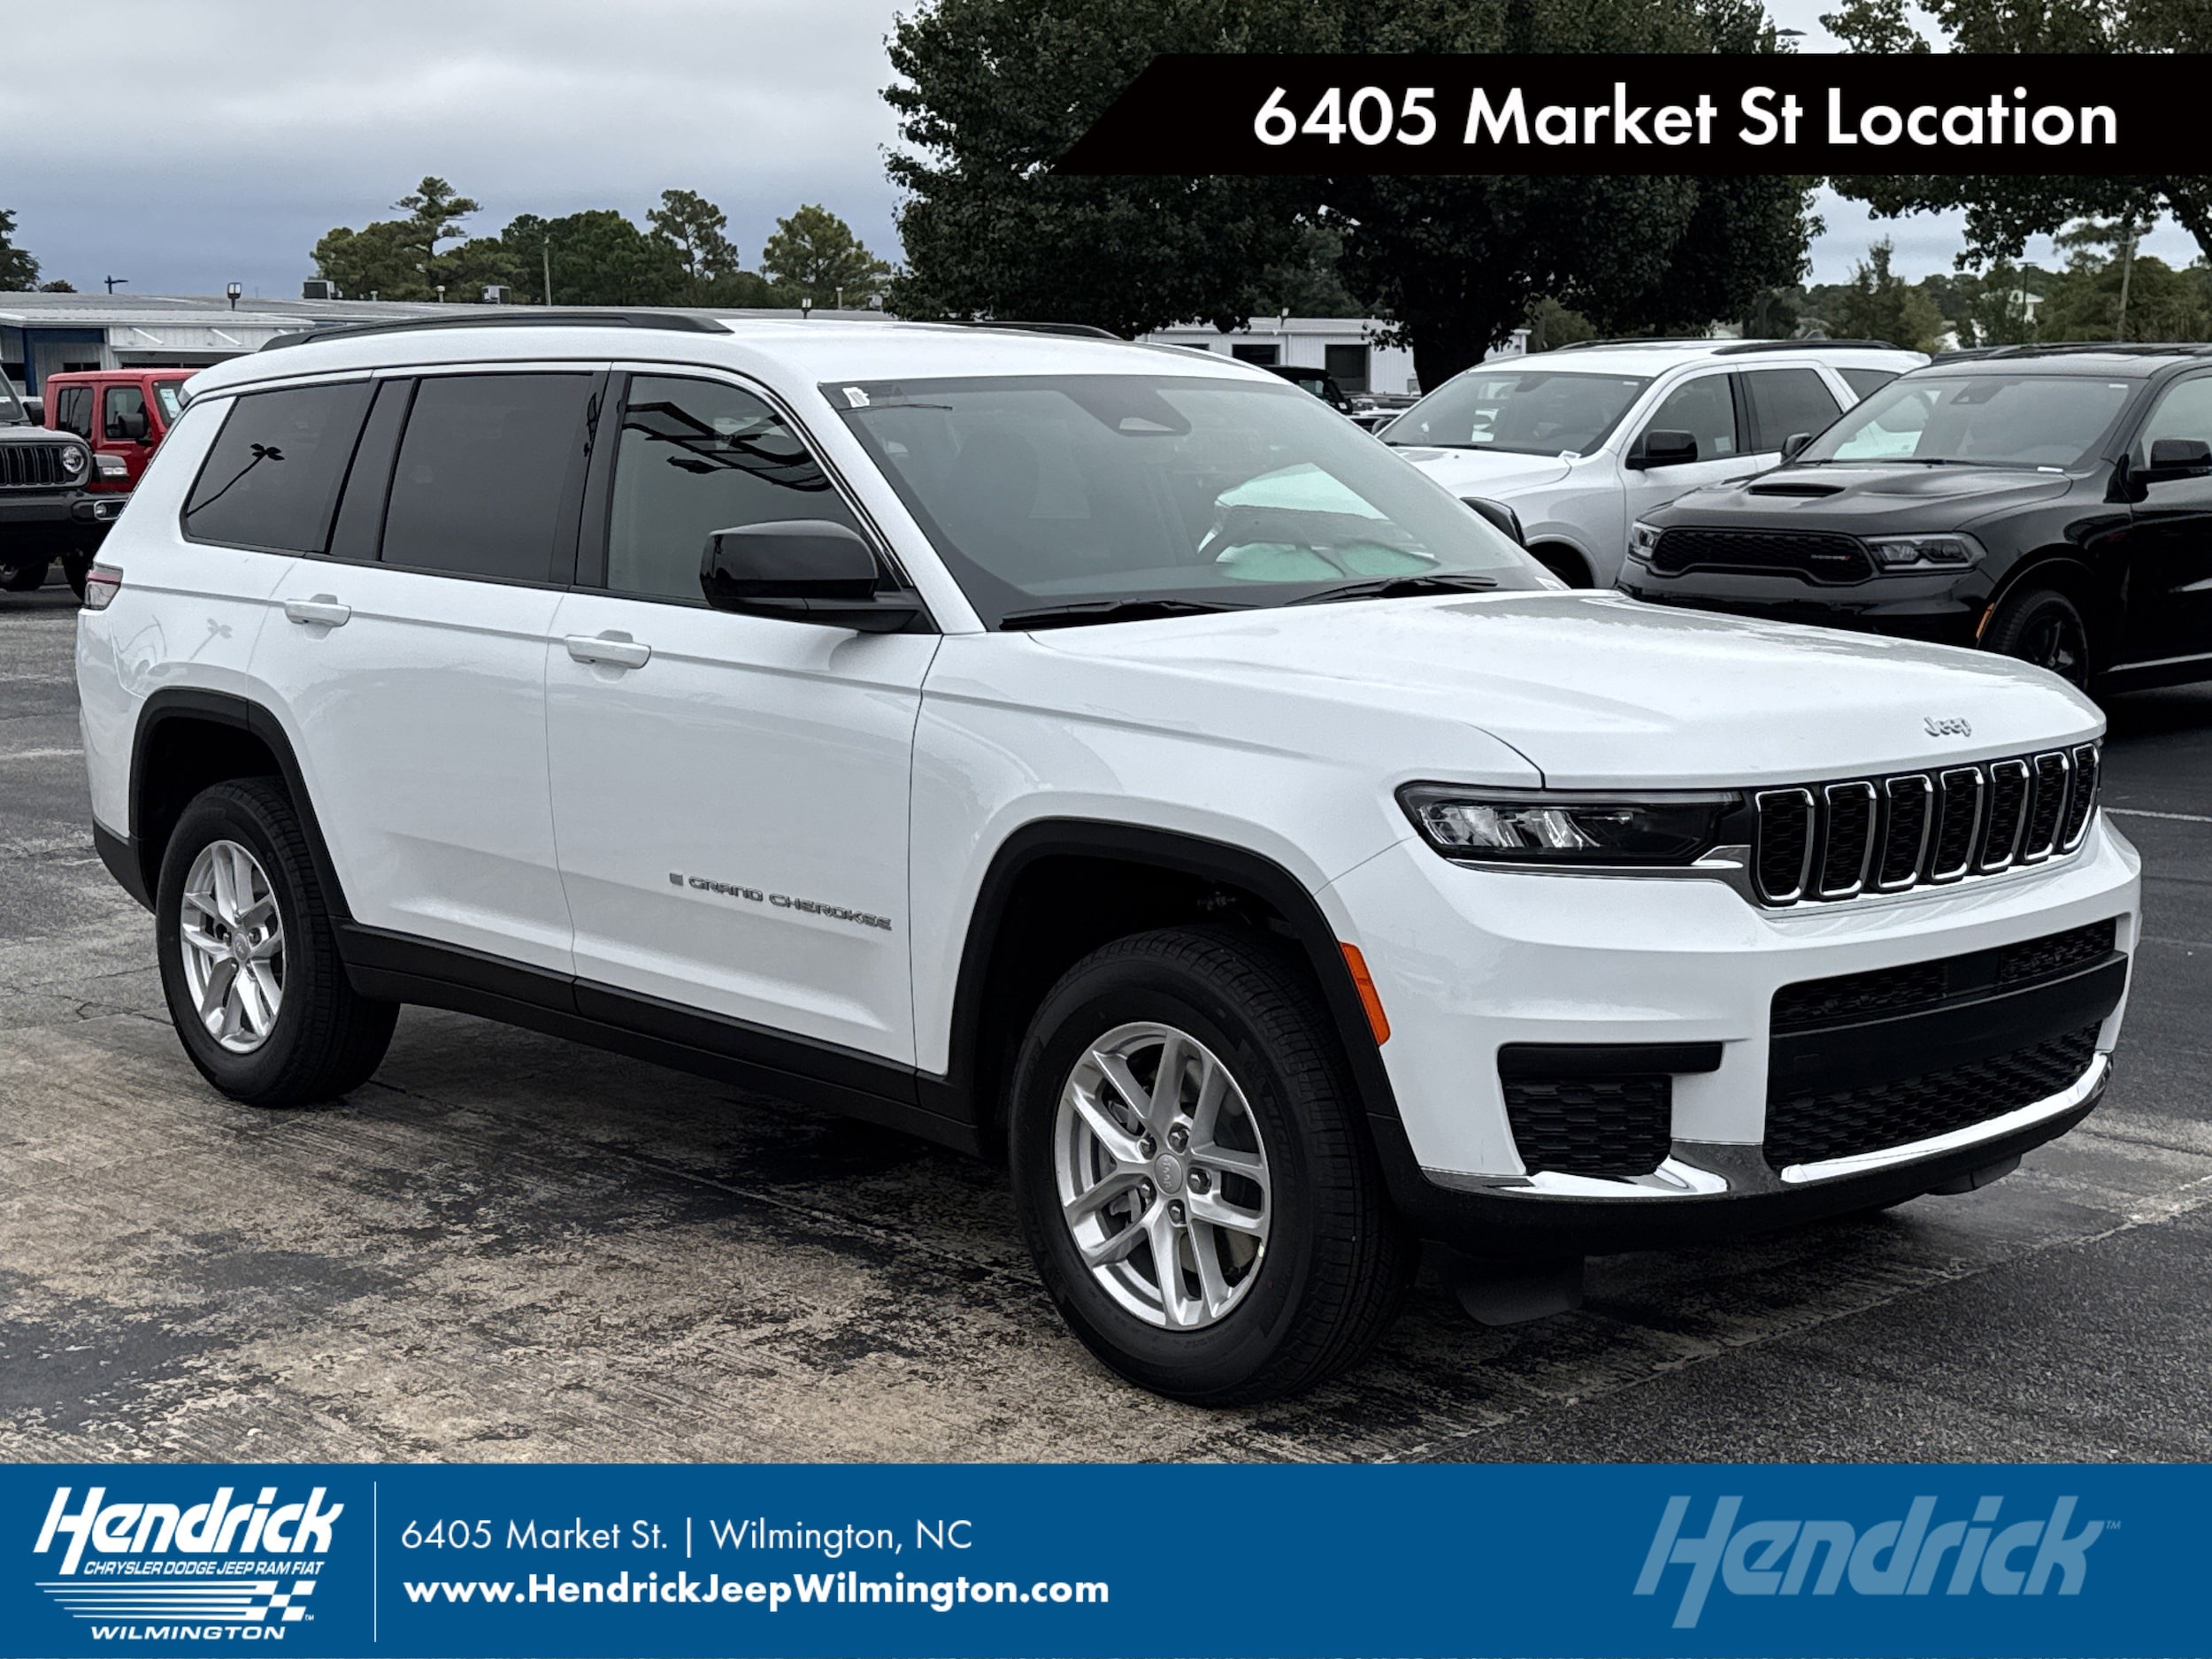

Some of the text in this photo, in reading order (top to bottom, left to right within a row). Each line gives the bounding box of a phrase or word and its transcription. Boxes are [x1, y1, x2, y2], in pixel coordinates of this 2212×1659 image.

[1924, 717, 1971, 737] Jeep
[688, 875, 892, 931] GRAND CHEROKEE
